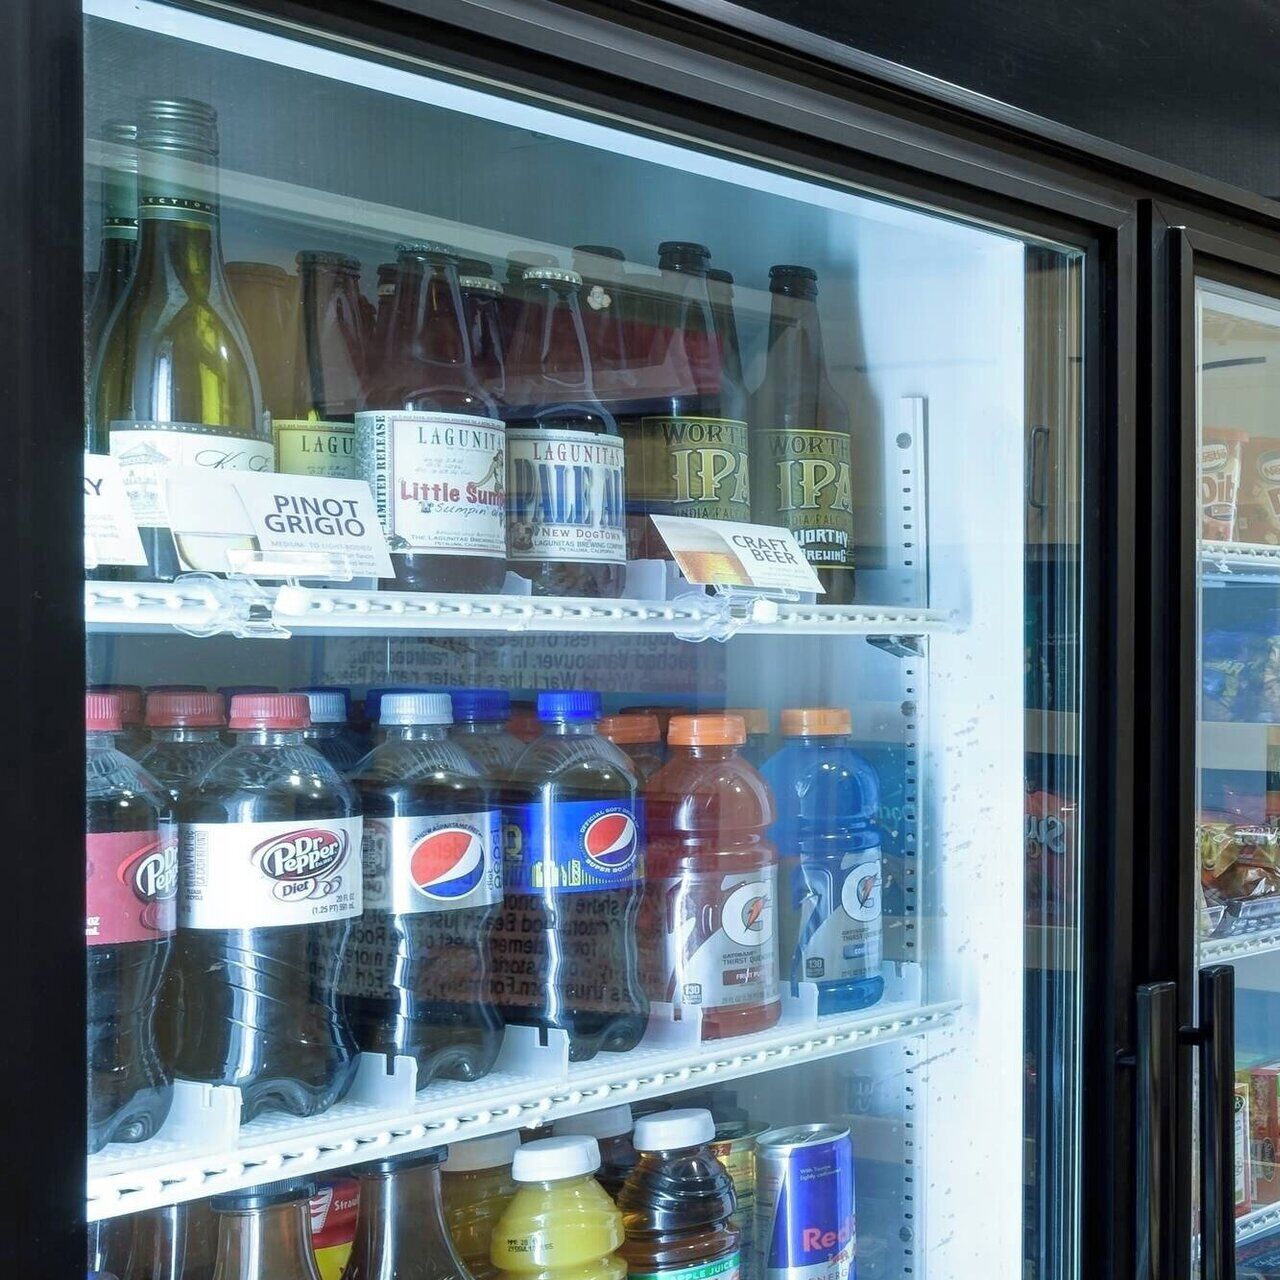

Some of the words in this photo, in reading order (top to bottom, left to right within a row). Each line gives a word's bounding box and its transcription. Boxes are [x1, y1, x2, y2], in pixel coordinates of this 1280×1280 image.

[375, 415, 386, 470] RELEASE
[533, 443, 622, 465] LAGUNITAS
[400, 478, 460, 503] Little
[776, 459, 853, 513] IPA
[273, 495, 359, 518] PINOT
[265, 513, 365, 537] GRIGIO
[732, 534, 787, 552] CRAFT
[753, 549, 797, 566] BEER
[301, 829, 323, 852] Dr
[270, 841, 338, 877] Pepper
[281, 882, 309, 898] Diet
